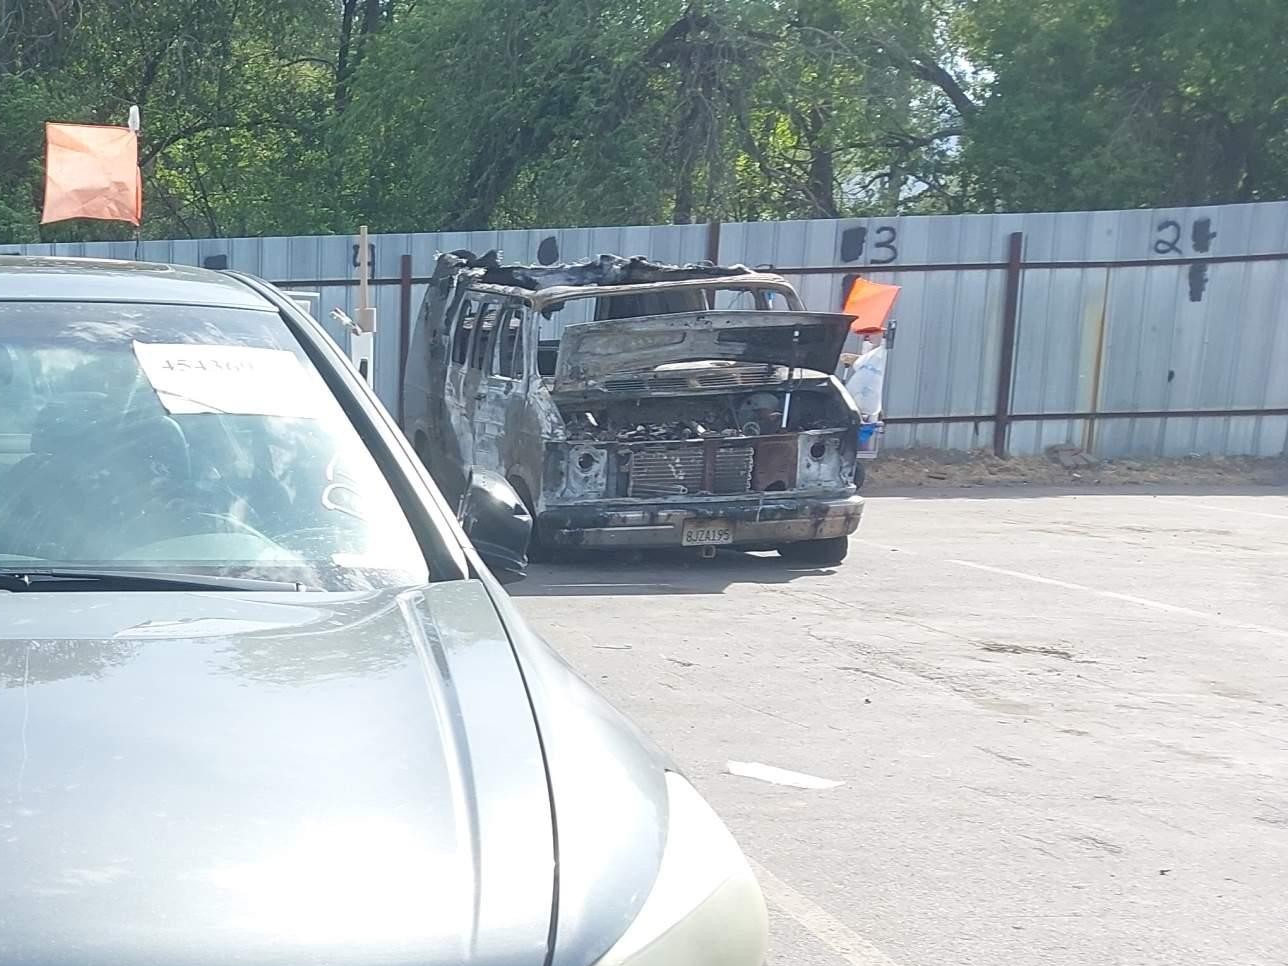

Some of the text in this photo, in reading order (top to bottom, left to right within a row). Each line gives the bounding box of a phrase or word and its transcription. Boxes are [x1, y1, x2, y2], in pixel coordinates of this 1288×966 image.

[869, 226, 899, 265] 3
[1153, 220, 1183, 256] 2
[686, 528, 730, 542] 8JZA195
